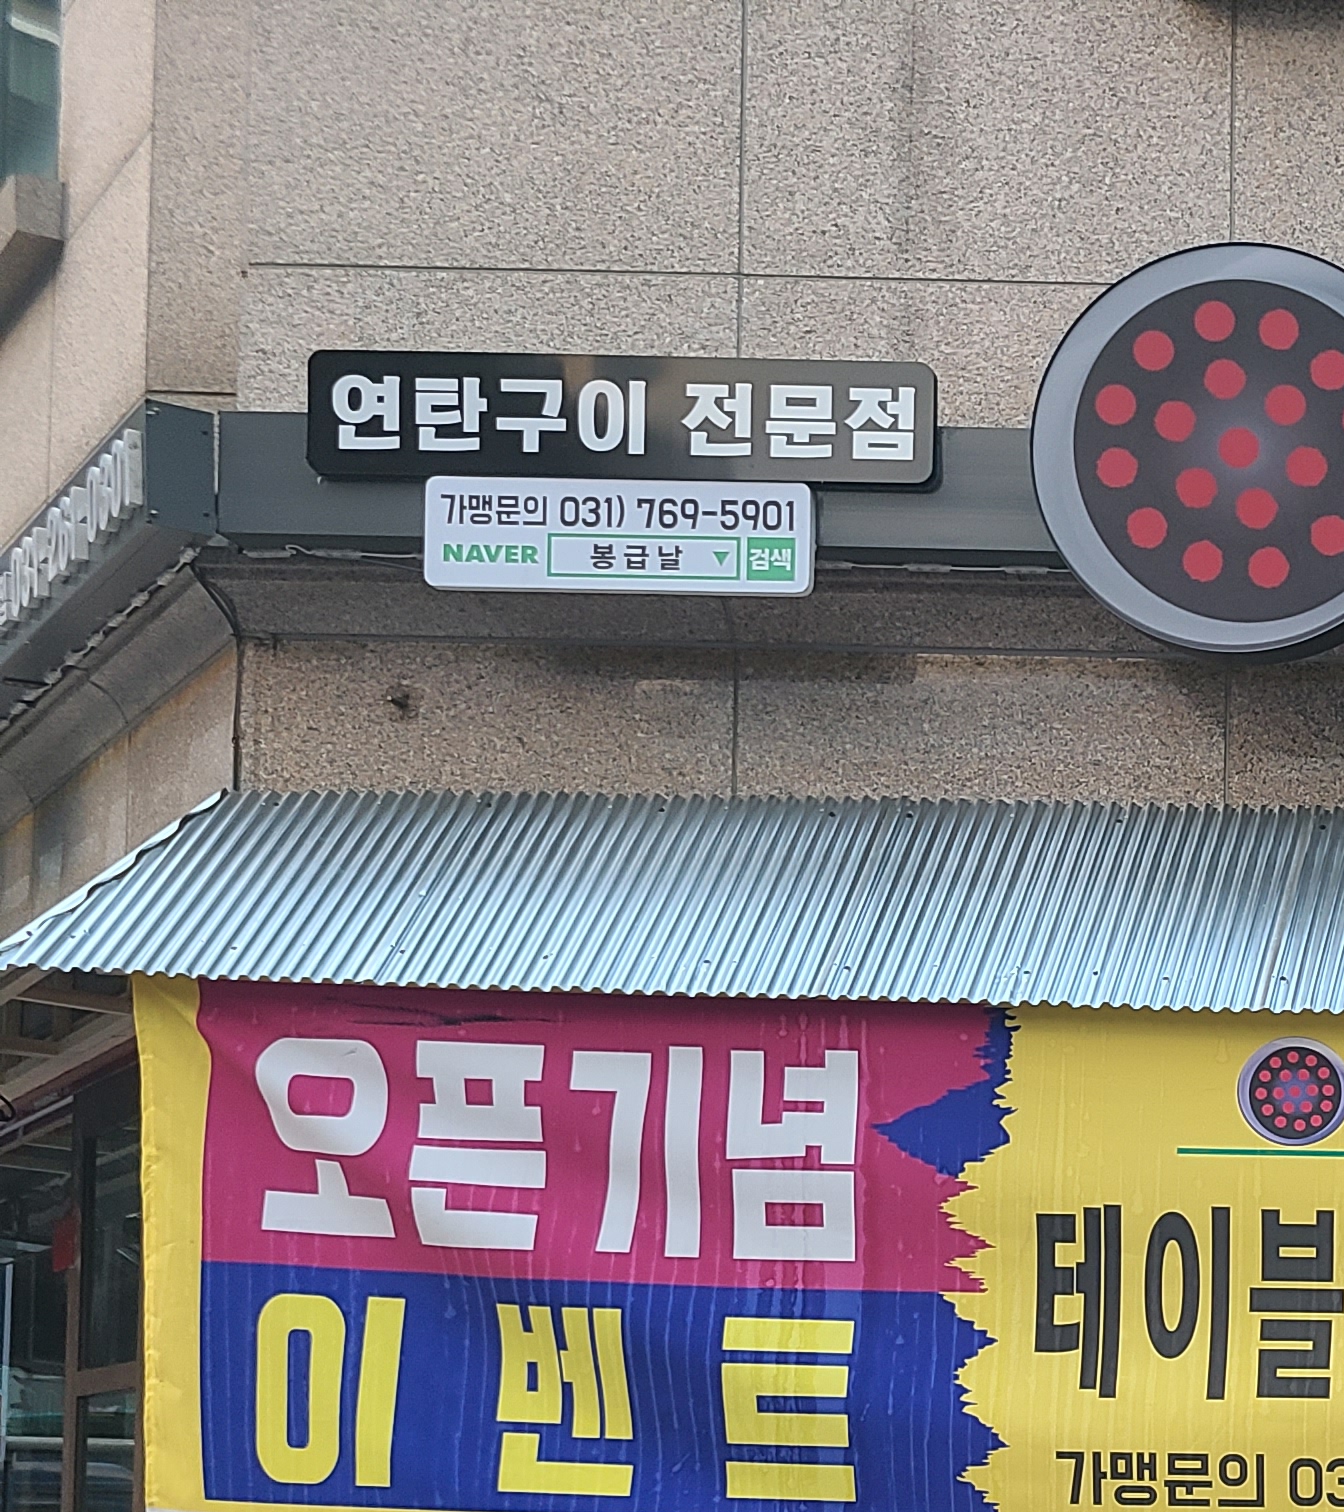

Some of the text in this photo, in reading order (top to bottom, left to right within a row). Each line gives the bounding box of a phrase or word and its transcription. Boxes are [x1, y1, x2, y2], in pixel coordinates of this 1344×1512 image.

[331, 374, 917, 462] 연탄구이 전문점
[439, 493, 796, 532] 가맹문의 031) 769-5901
[442, 542, 793, 572] NAVER 봉급날 검색
[254, 1036, 860, 1262] 오픈기념
[255, 1293, 857, 1502] 이벤트
[1055, 1449, 1267, 1507] 가맹문의
